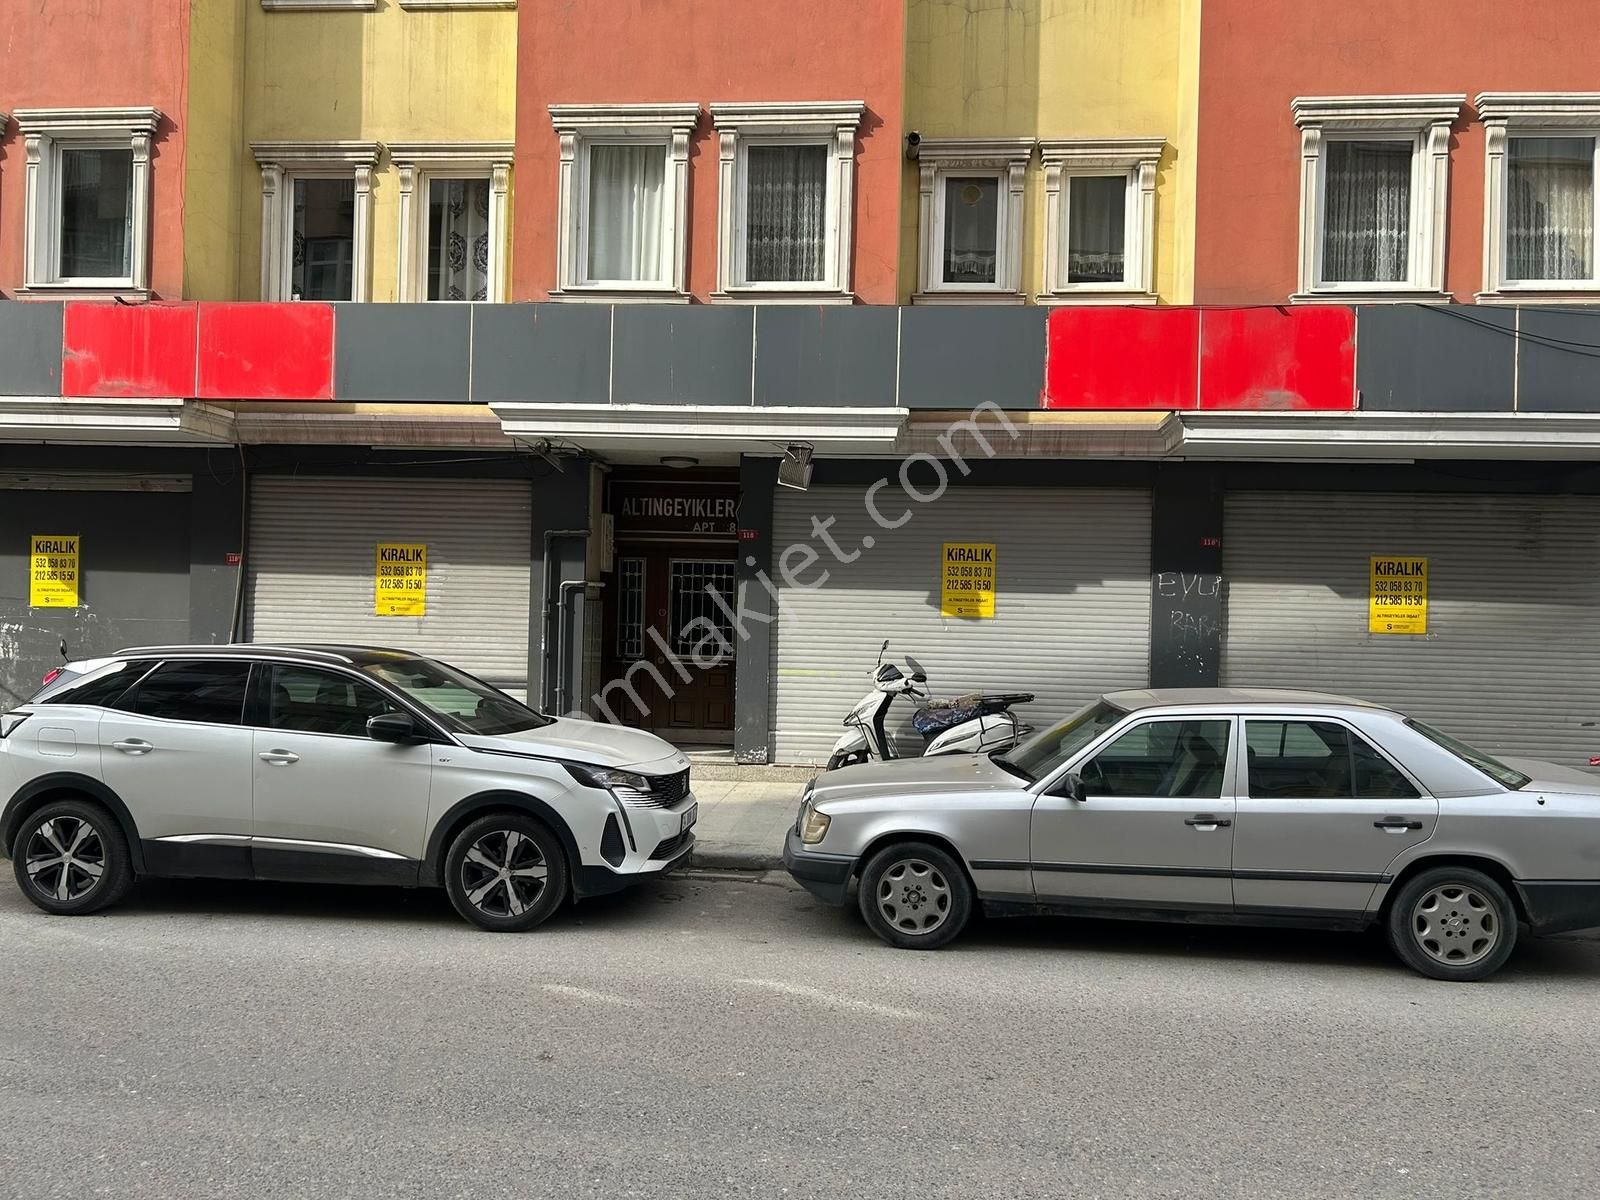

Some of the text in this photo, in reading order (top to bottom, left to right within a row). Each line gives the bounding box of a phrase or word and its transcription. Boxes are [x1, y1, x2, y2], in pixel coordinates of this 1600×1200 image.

[622, 497, 735, 518] ALTINGEYIKLER
[692, 522, 715, 533] APT
[36, 558, 75, 568] 532 058 83 70
[35, 570, 74, 581] 212 585 15 50
[380, 566, 422, 576] 532 058 83 70
[948, 566, 992, 577] 532 058 83 70
[380, 578, 422, 590] 212 585 15 50
[946, 579, 991, 591] 212 585 15 50
[1375, 581, 1423, 592] 532 058 83 70
[1375, 595, 1423, 606] 212 585 15 50
